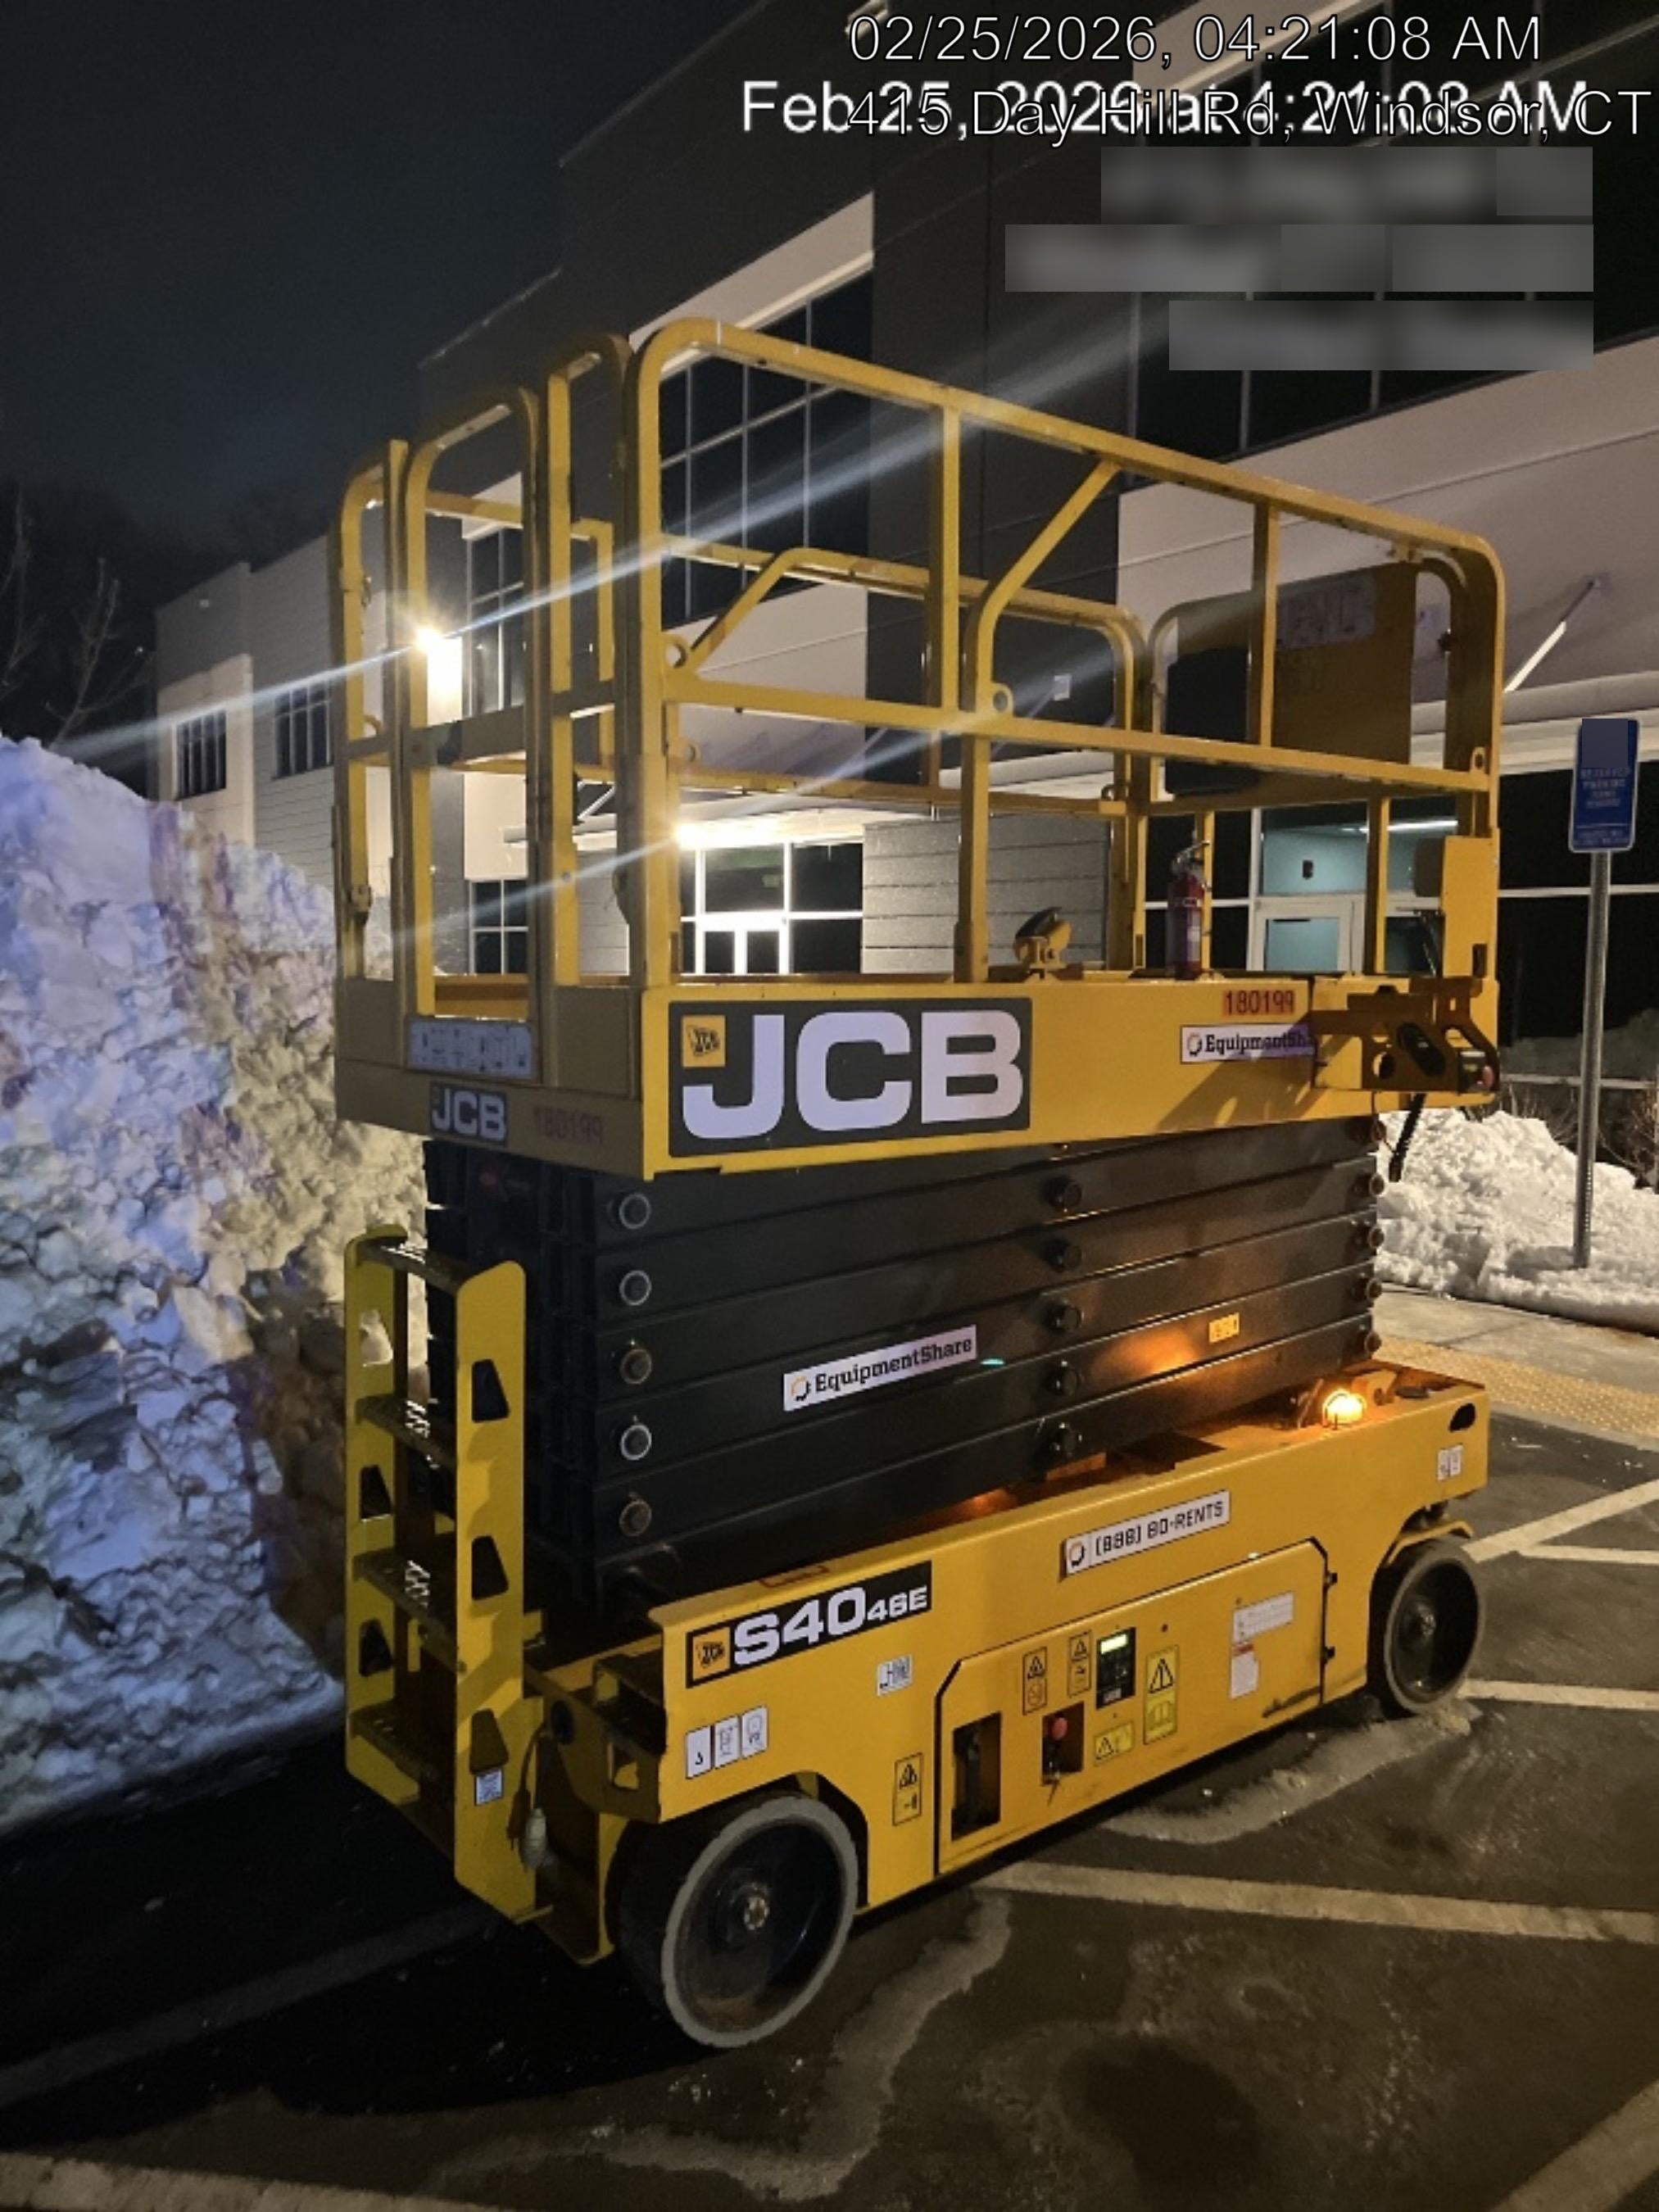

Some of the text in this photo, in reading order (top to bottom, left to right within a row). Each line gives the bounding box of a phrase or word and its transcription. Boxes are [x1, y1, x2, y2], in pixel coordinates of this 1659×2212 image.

[1226, 989, 1295, 1015] 180199
[682, 1009, 1023, 1140] JCB
[431, 1087, 507, 1142] JCB
[814, 1339, 972, 1393] EquipmentShare
